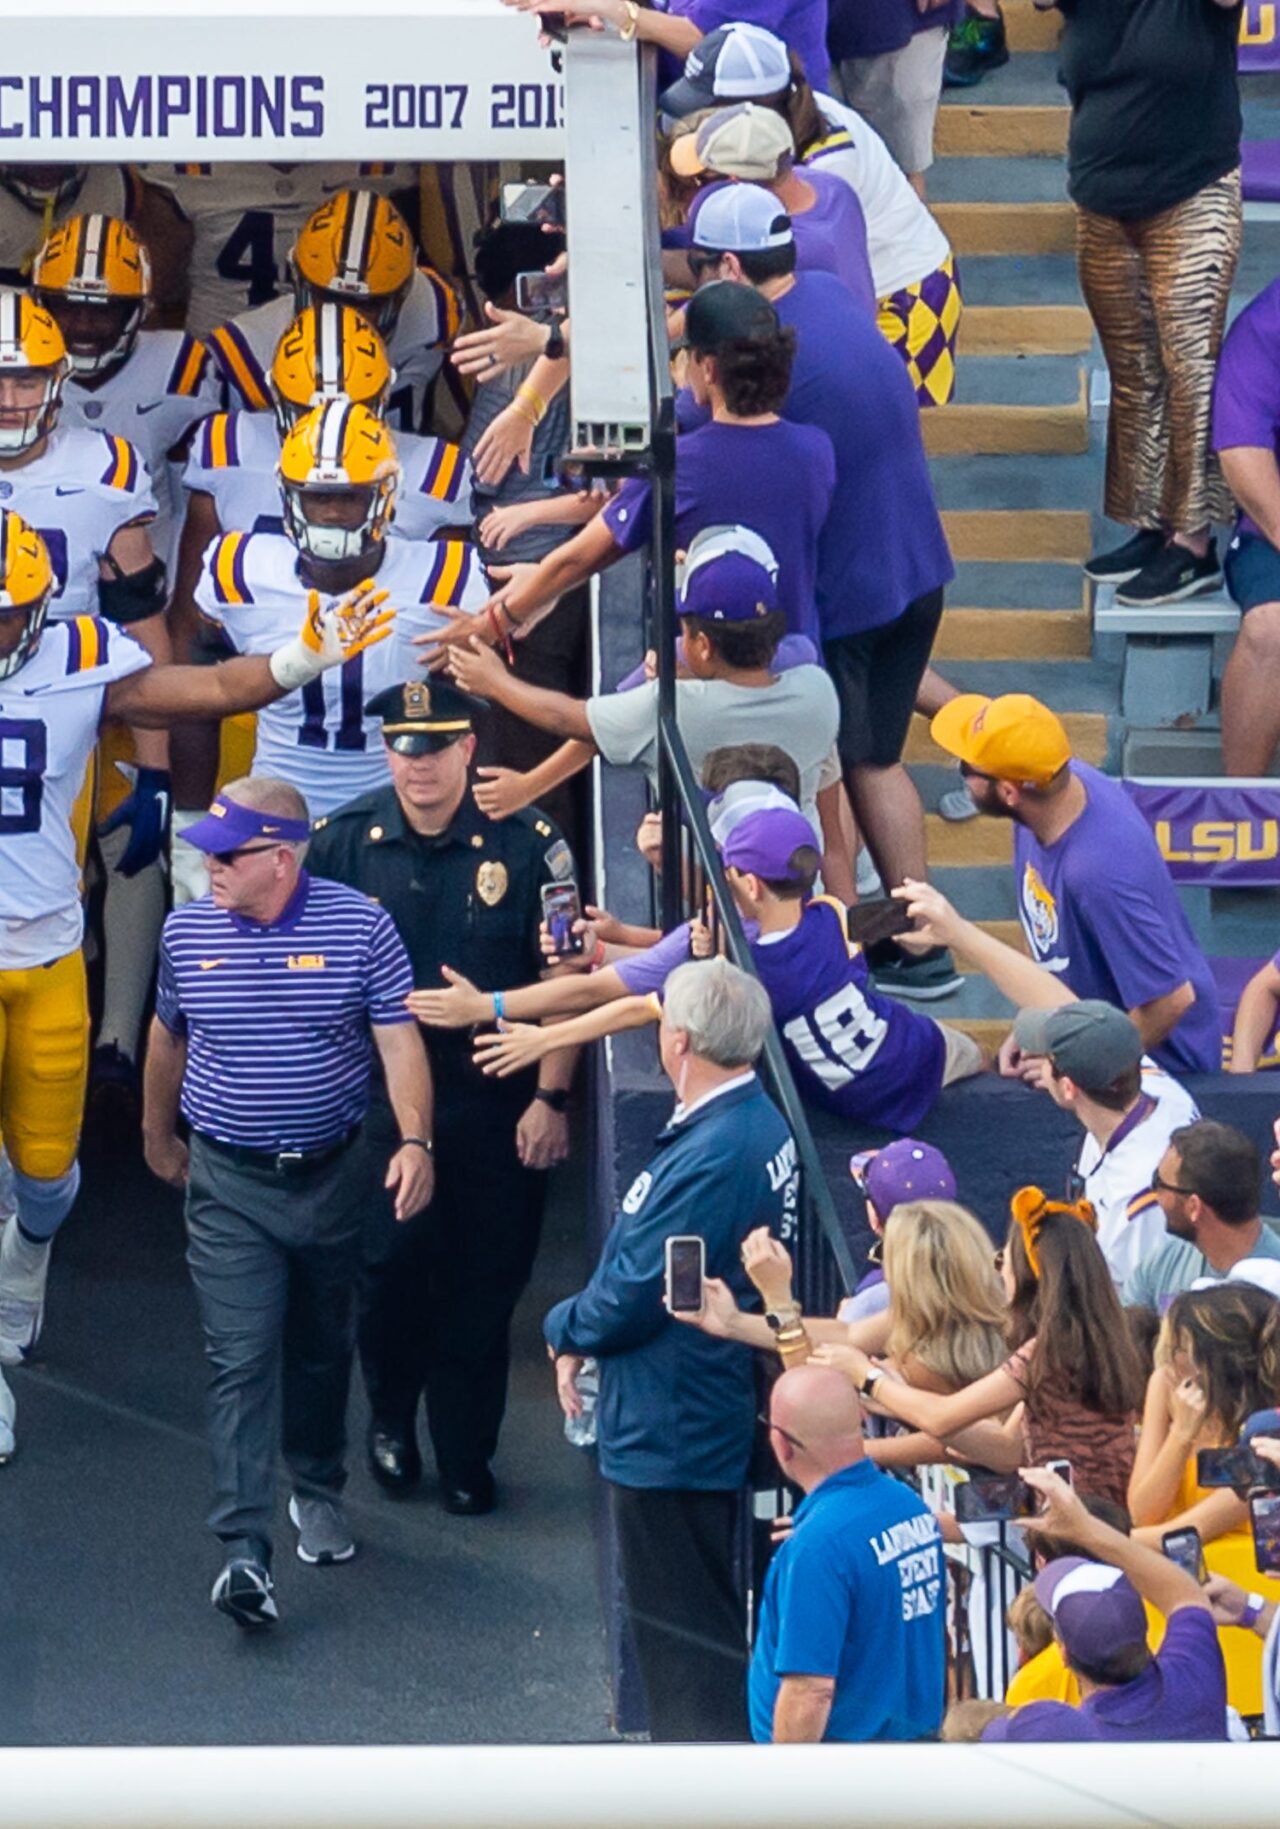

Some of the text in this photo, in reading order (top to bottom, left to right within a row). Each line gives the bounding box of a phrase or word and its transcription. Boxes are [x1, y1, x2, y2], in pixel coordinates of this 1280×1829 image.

[366, 84, 469, 129] 2007
[297, 651, 367, 751] 11
[1155, 819, 1279, 862] LSU
[783, 981, 889, 1092] 18
